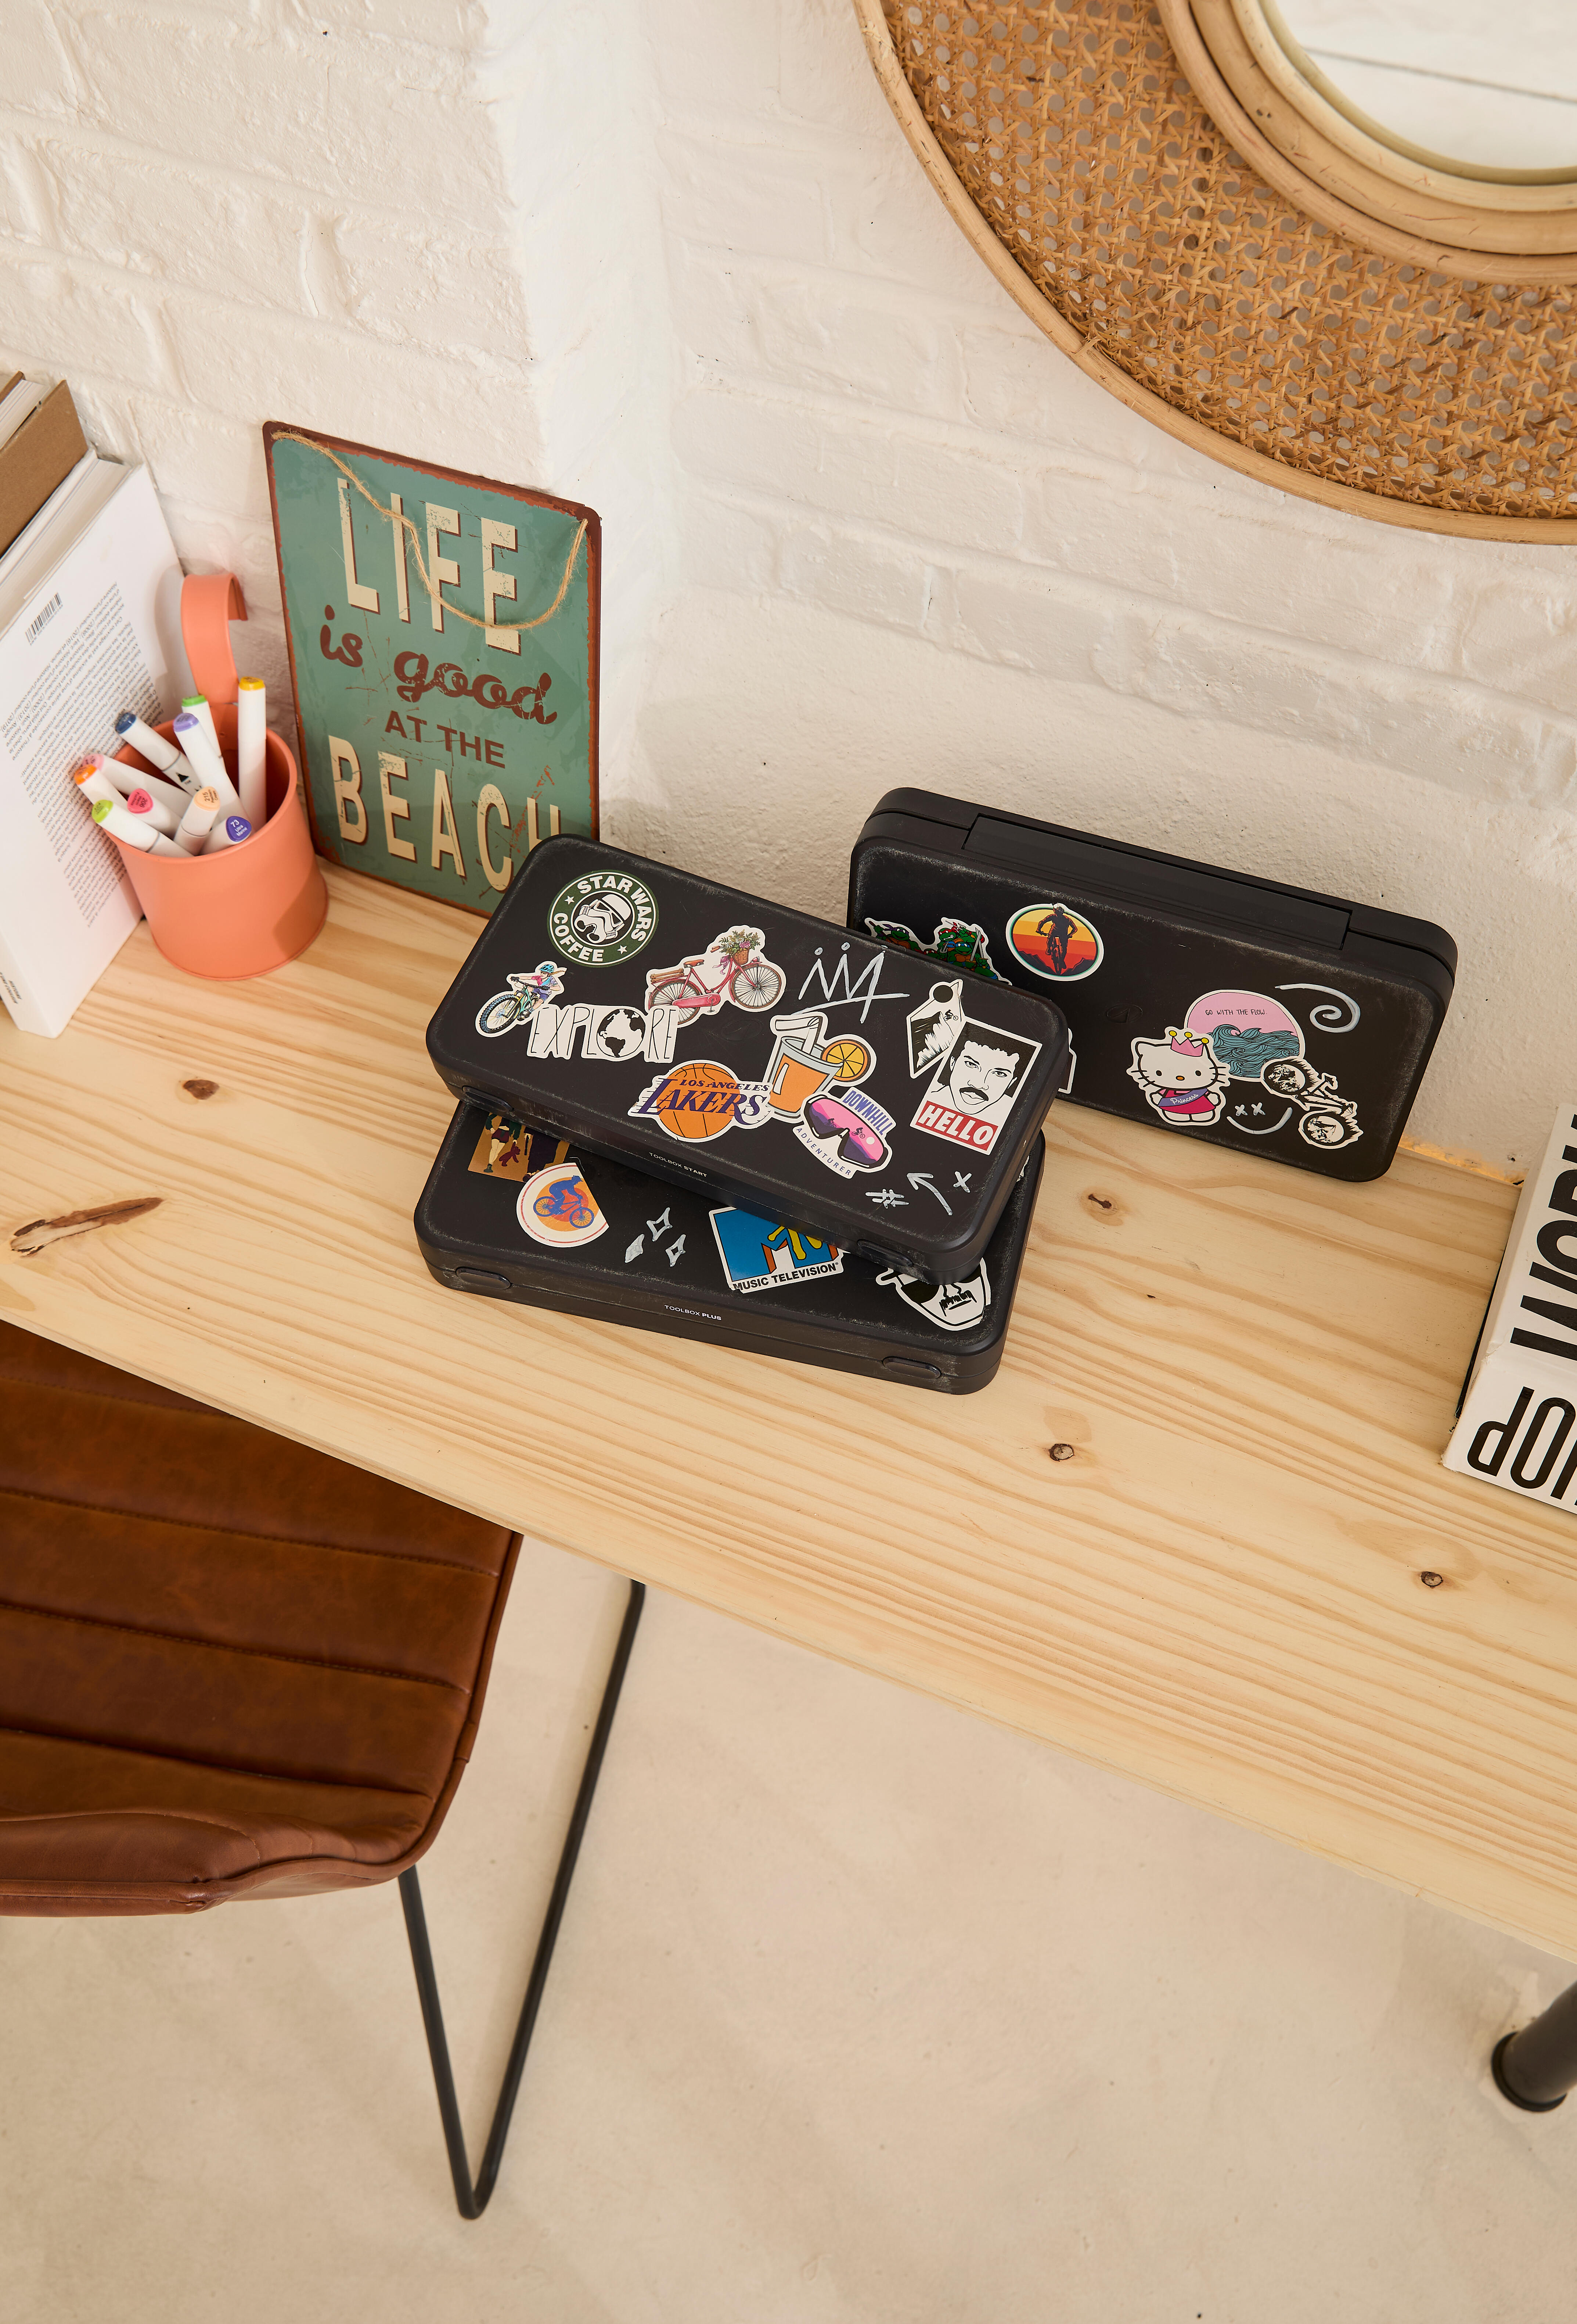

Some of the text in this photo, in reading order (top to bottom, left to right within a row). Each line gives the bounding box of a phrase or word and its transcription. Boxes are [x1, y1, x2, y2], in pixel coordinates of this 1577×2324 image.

[337, 477, 521, 656] LIFE
[320, 605, 558, 724] is good
[384, 710, 505, 769] AT THE
[140, 798, 148, 808] 206
[230, 819, 240, 828] 73
[236, 827, 248, 837] Marine
[577, 875, 652, 941] STAR WARS
[553, 913, 604, 962] COFFEE
[630, 1078, 771, 1125] LAKERS
[705, 1082, 770, 1091] ANGELES
[1170, 1094, 1199, 1105] Princess
[842, 1090, 893, 1136] DOWNHILL
[918, 1104, 993, 1145] HELLO
[649, 1152, 707, 1177] TOOLBOX START
[796, 1127, 851, 1176] ADVENTURER
[732, 1277, 769, 1291] MUSIC
[664, 1305, 722, 1321] TOOLBOX PLUS
